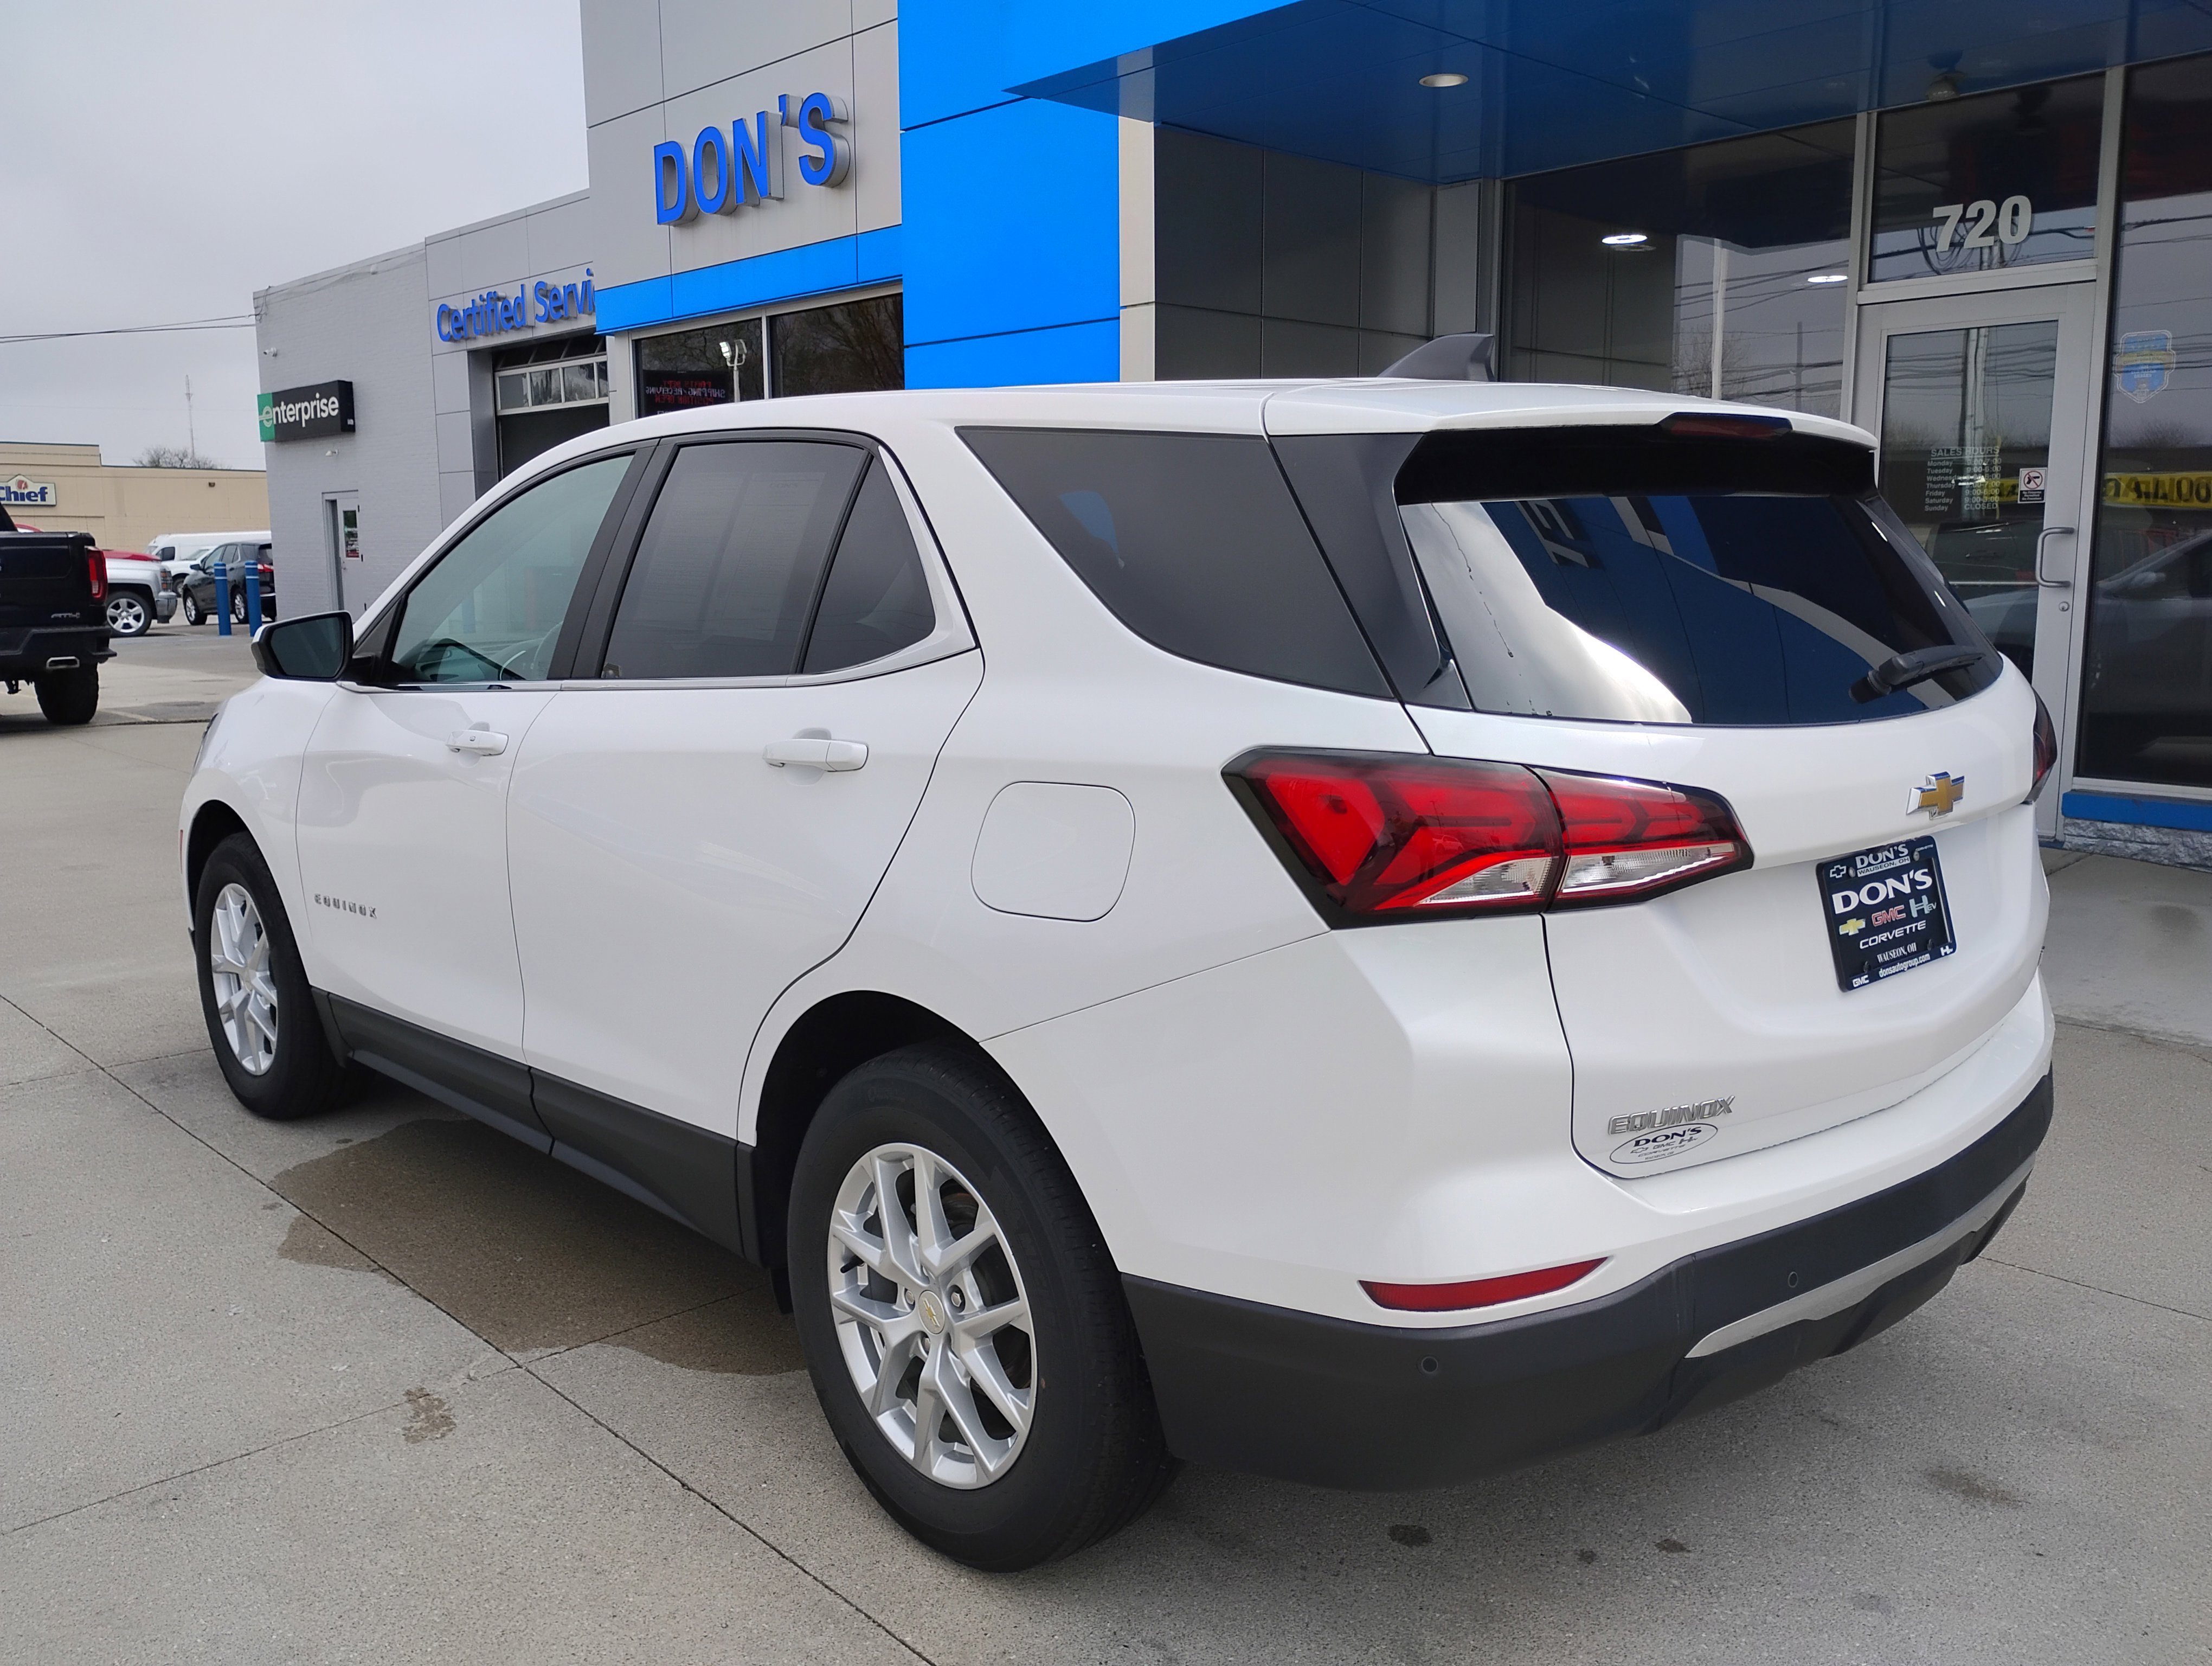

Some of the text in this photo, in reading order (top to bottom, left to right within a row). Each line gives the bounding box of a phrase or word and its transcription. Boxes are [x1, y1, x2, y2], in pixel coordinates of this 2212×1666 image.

[654, 92, 842, 226] DON'S
[1933, 195, 2032, 252] 720
[437, 268, 595, 342] Certified Servi
[259, 393, 339, 428] enterprise
[1931, 446, 1999, 457] SALES HOURS
[1855, 844, 1908, 868] DON'S
[1859, 861, 1897, 875] WAUSEON,
[1831, 869, 1933, 914] DON'S
[314, 893, 377, 919] EQUINOX
[1872, 905, 1906, 927] GMC
[1860, 920, 1926, 949] CORVETTE
[1877, 943, 1917, 963] WAUSEON, OH
[1879, 953, 1931, 978] donsautogroup.com
[1853, 975, 1869, 988] GMC
[1608, 1095, 1735, 1135] EQUINOX
[1634, 1126, 1702, 1147] DON'S
[1653, 1141, 1676, 1149] GMC
